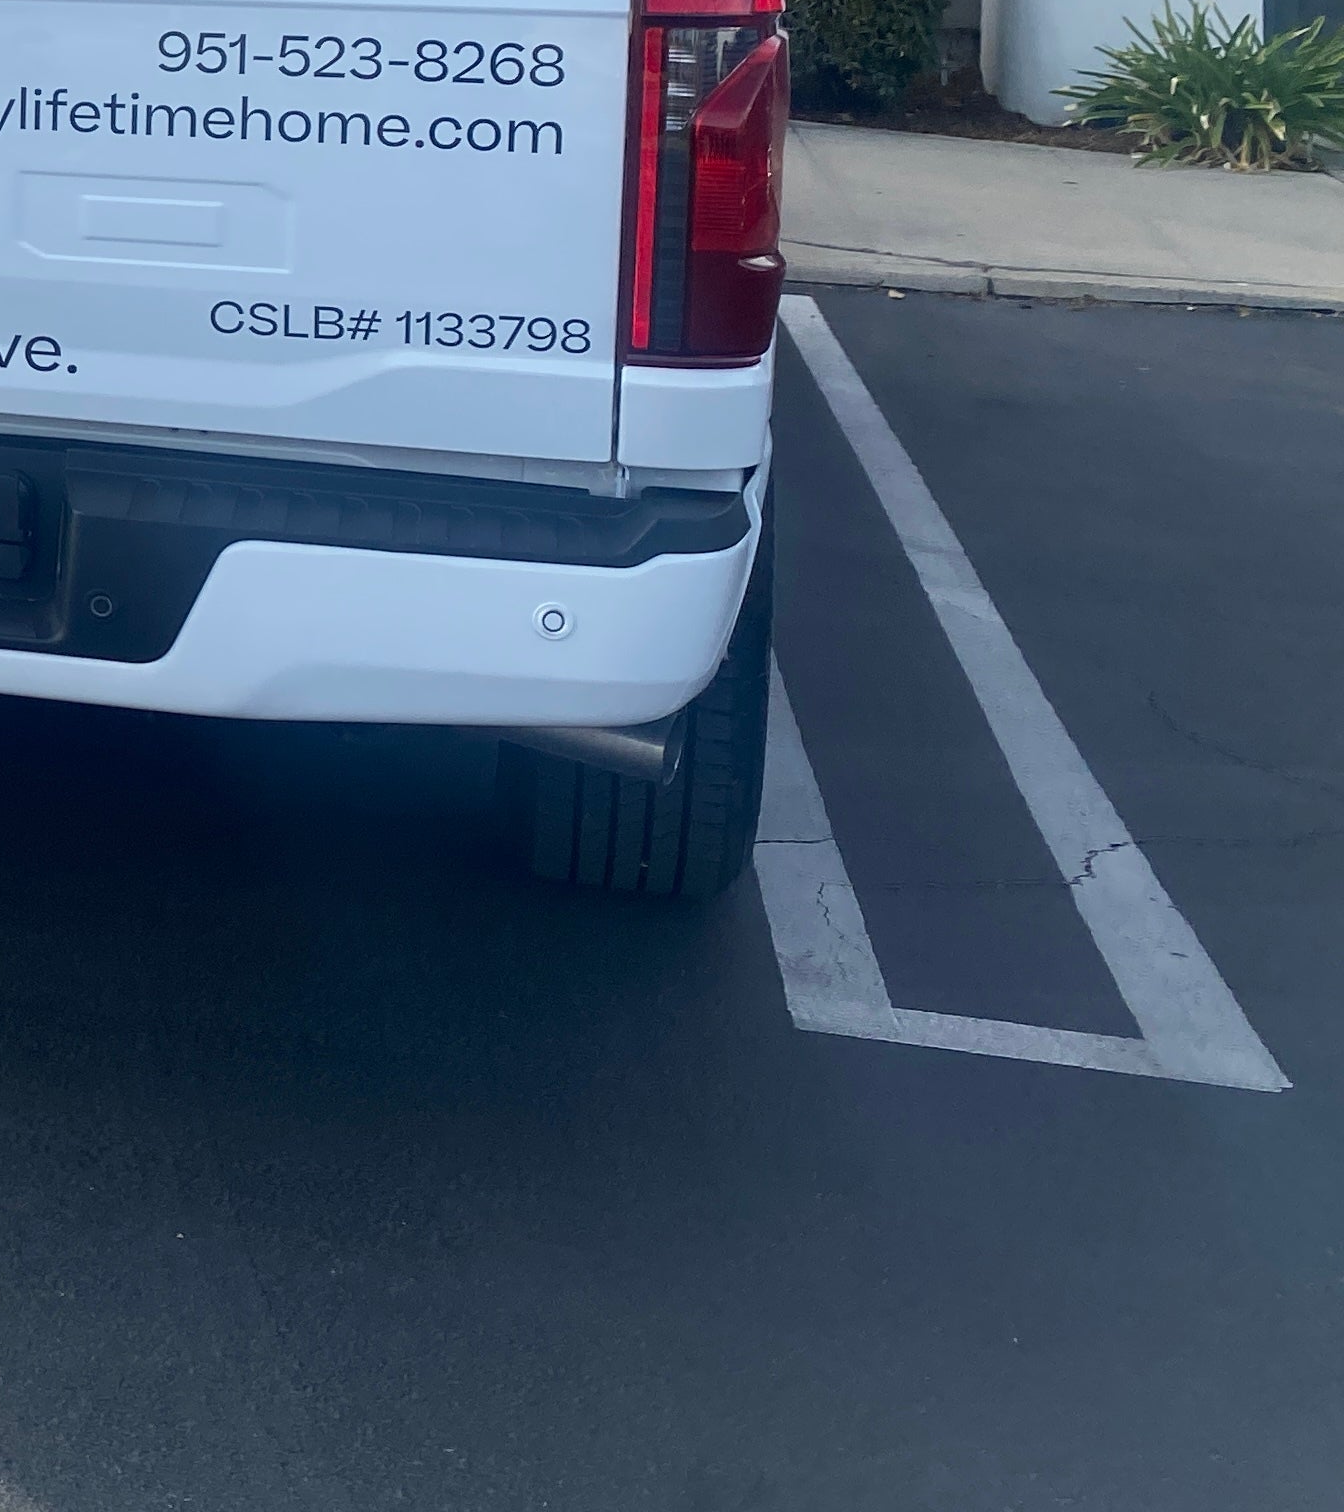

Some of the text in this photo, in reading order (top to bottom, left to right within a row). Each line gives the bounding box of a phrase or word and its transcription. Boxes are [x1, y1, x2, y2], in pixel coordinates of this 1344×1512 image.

[158, 30, 565, 87] 951-523-8268
[210, 300, 591, 354] CSLB# 1133798
